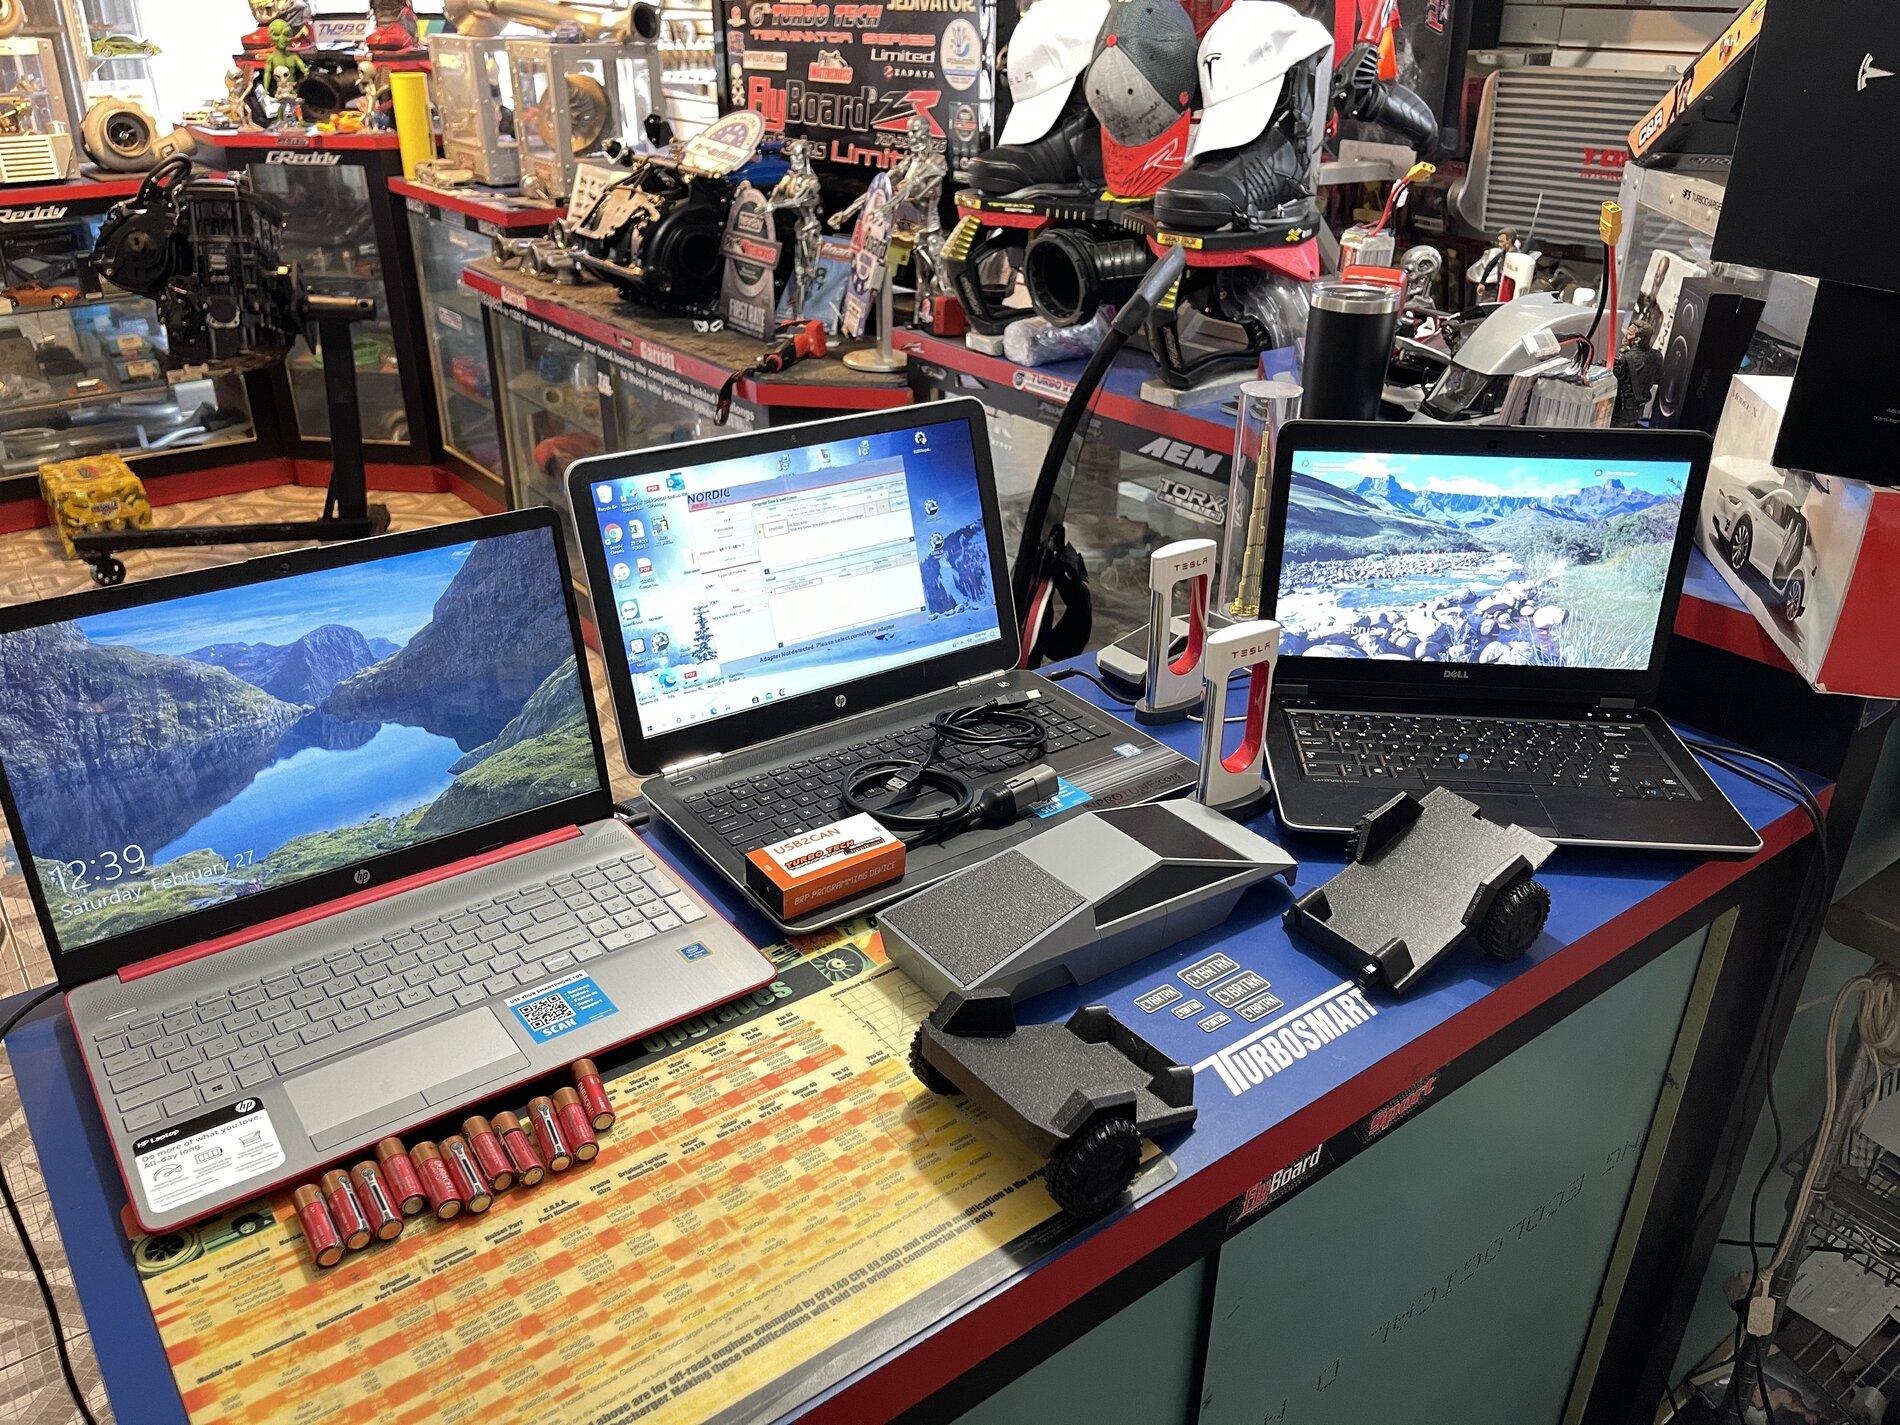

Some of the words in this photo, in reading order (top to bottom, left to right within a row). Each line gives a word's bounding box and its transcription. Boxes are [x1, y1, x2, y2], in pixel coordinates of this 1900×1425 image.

[750, 29, 853, 44] TERMINATOR
[861, 33, 937, 46] SERIES
[871, 48, 936, 63] Limited
[895, 69, 936, 78] ZAPATA
[266, 151, 342, 165] GReddy
[1139, 437, 1224, 475] AEM
[688, 487, 731, 504] NORDIC
[1160, 477, 1228, 512] TORX
[1174, 557, 1208, 572] TESLA
[1232, 642, 1271, 659] TESLA
[1444, 670, 1469, 679] DELL
[773, 828, 841, 854] USB2CAN
[784, 850, 824, 870] TURBO
[825, 839, 856, 854] TECH
[50, 844, 146, 893] 12:39
[61, 886, 147, 919] Saturday,
[151, 860, 229, 892] February
[234, 850, 254, 868] 27
[794, 893, 811, 906] BRP
[811, 873, 868, 897] PROGRAMMING
[869, 860, 897, 877] DEVICE
[1185, 956, 1234, 987] CYBRTRK
[521, 990, 536, 1001] YOUR
[537, 977, 572, 996] SMARTPHONE
[1138, 987, 1178, 1011] CYBRTRK
[1214, 974, 1265, 1004] CYBRTRK
[1240, 995, 1279, 1020] CYBRTRK
[542, 1019, 578, 1037] SCAN
[1196, 982, 1378, 1096] TURBOSMART
[835, 1070, 853, 1082] Turbo
[578, 1081, 595, 1115] DURACELL
[800, 1086, 818, 1100] Turbo
[137, 1139, 149, 1148] HP
[150, 1129, 179, 1144] Laptop
[142, 1155, 155, 1163] Do
[157, 1145, 181, 1157] more
[184, 1139, 194, 1147] of
[196, 1130, 219, 1142] what
[221, 1122, 238, 1134] you
[239, 1114, 263, 1125] love.
[144, 1154, 178, 1169] All-day
[179, 1145, 203, 1157] long.
[433, 1160, 456, 1193] DURACELL
[617, 1162, 642, 1179] Original
[626, 1164, 653, 1182] Housing
[652, 1158, 668, 1169] Size
[589, 1177, 611, 1192] Frame
[596, 1184, 611, 1196] Size
[537, 1211, 554, 1224] Part
[553, 1199, 580, 1216] Number
[493, 1227, 523, 1245] Number
[507, 1218, 524, 1231] Part
[216, 1245, 270, 1273] Transmission
[430, 1262, 448, 1275] Part
[447, 1248, 477, 1267] Number
[1371, 1173, 1586, 1342] ECOLOGICAL
[164, 1280, 190, 1296] Model
[190, 1271, 209, 1284] Year
[373, 1289, 391, 1301] Part
[391, 1275, 422, 1293] Number
[593, 1400, 632, 1425] above
[629, 1388, 653, 1407] are
[649, 1378, 669, 1396] for
[665, 1354, 712, 1386] off-road
[709, 1331, 755, 1362] engines
[751, 1302, 805, 1338] exempted
[800, 1295, 817, 1310] by
[813, 1285, 834, 1302] EPA
[847, 1265, 869, 1283] CFR
[900, 1236, 922, 1254] and
[918, 1218, 955, 1244] require
[950, 1188, 1007, 1225] modification
[1003, 1183, 1016, 1196] to
[1012, 1175, 1030, 1190] the
[669, 1368, 713, 1398] Making
[709, 1350, 744, 1375] these
[739, 1310, 813, 1357] modifications
[808, 1299, 831, 1318] will
[827, 1288, 852, 1307] void
[848, 1278, 867, 1295] the
[864, 1257, 905, 1286] original
[900, 1228, 957, 1265] commercial
[953, 1205, 997, 1236] warranty.
